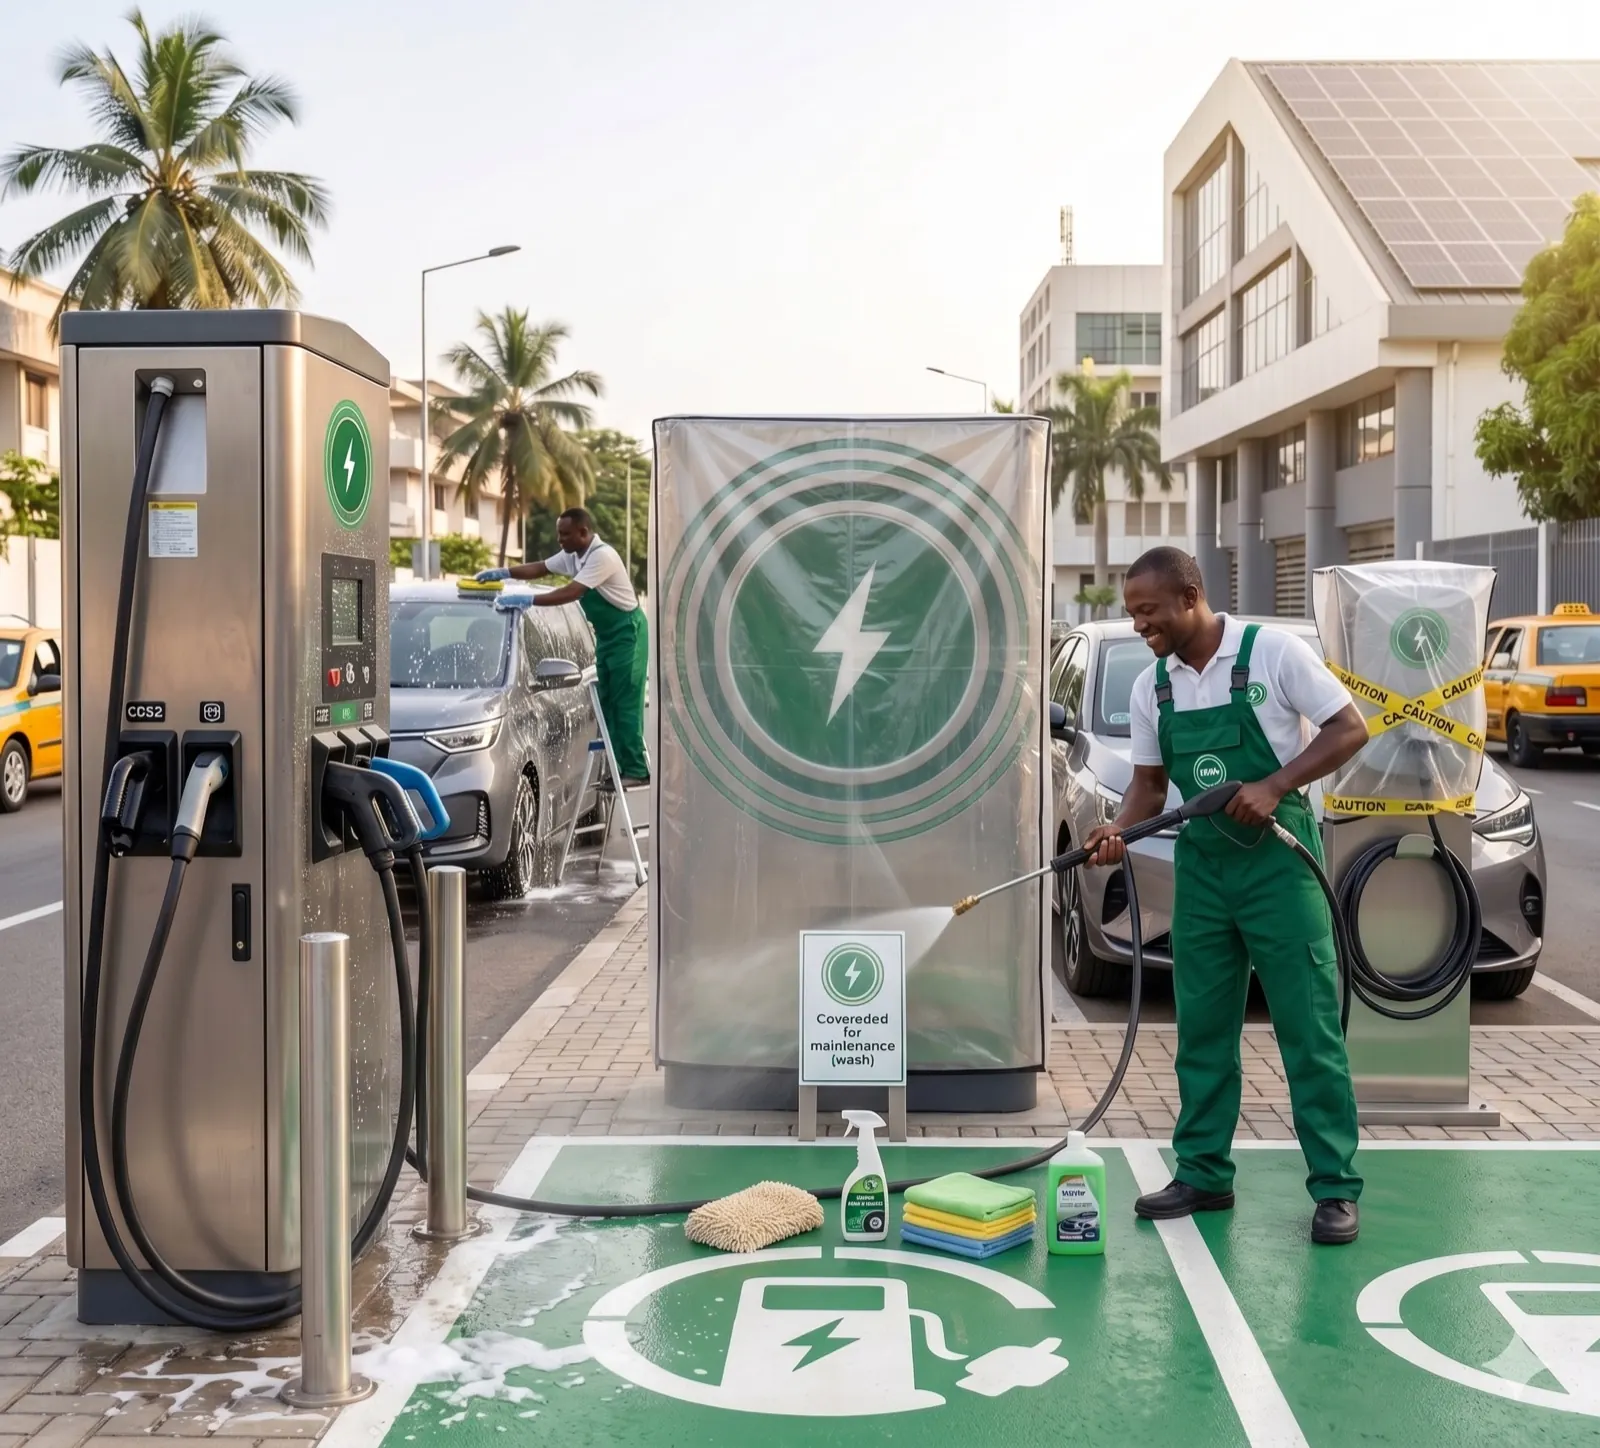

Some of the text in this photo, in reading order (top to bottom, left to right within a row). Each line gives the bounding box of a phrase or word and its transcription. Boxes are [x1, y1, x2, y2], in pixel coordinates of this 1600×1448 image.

[1340, 672, 1388, 703] CAUTION
[1402, 703, 1455, 734] CAUTION
[127, 705, 163, 718] CCS2
[1332, 799, 1386, 812] CAUTION
[816, 1013, 889, 1024] Covereded
[843, 1026, 862, 1038] for
[831, 1054, 875, 1068] (wash)
